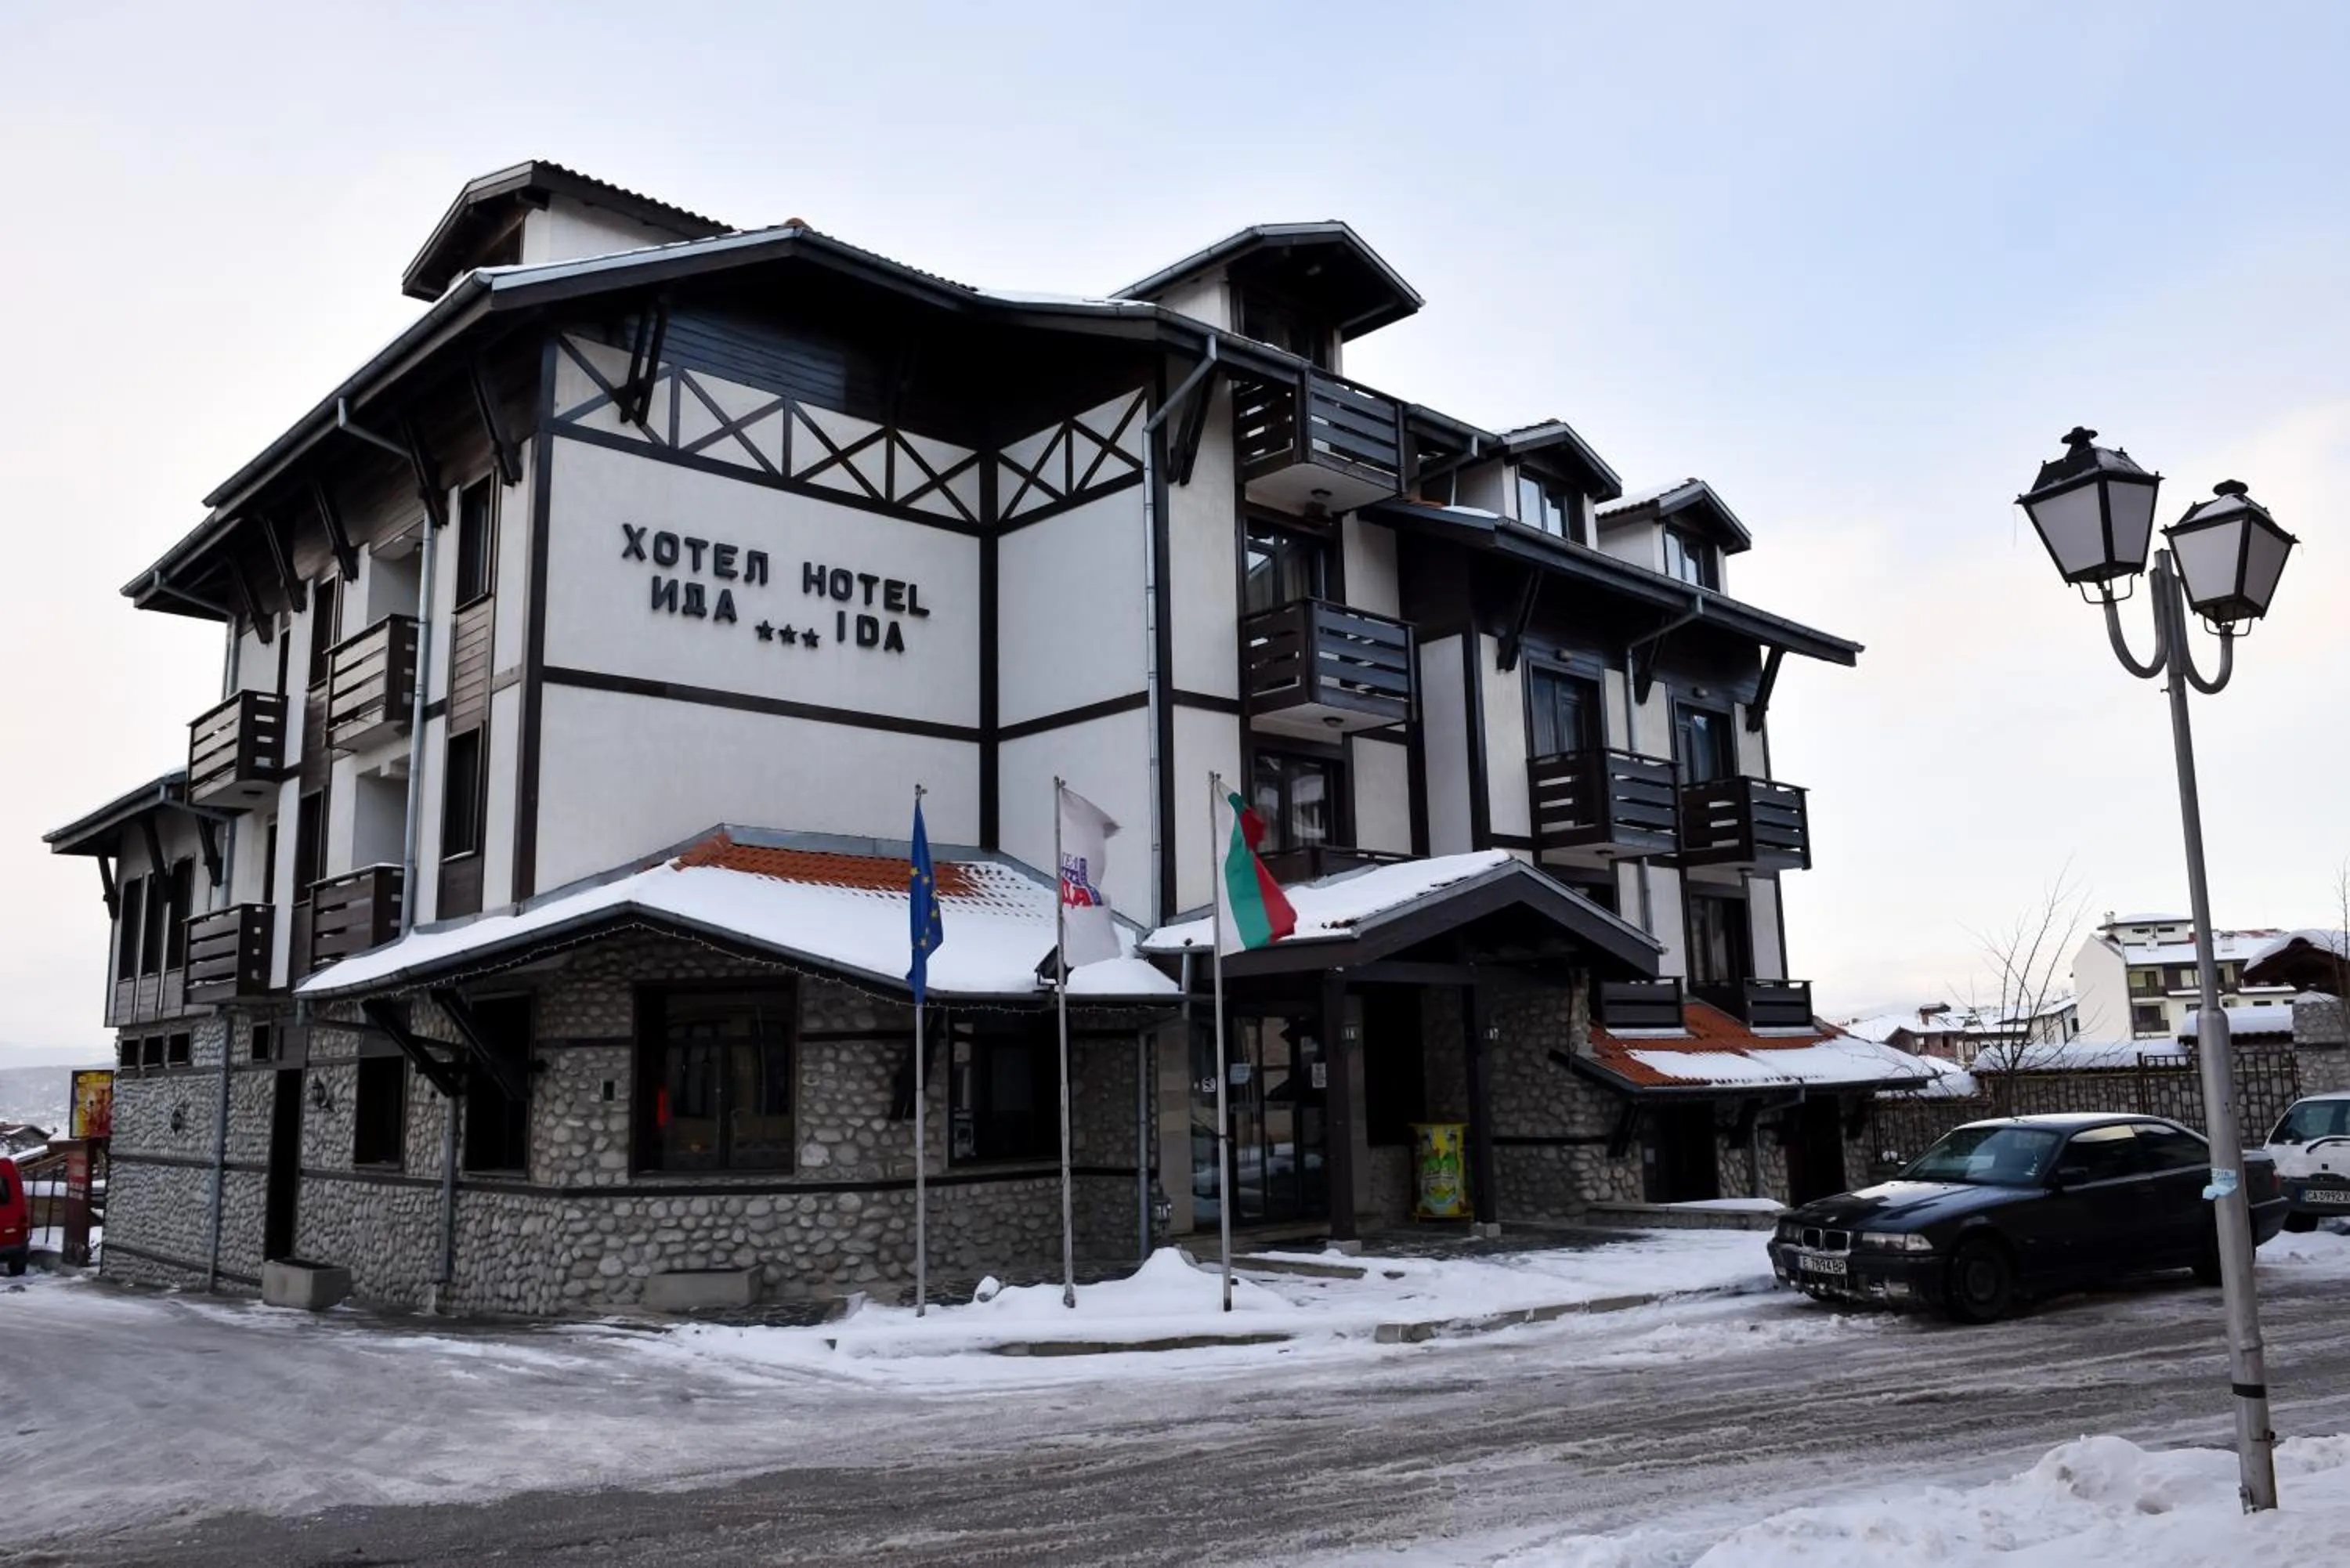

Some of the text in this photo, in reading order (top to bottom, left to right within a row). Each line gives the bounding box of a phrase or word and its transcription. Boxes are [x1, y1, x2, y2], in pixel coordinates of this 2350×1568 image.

[621, 522, 768, 587] ХОТЕЛ
[651, 575, 738, 626] ИДА
[802, 561, 931, 620] HOTEL
[836, 610, 906, 655] IDA
